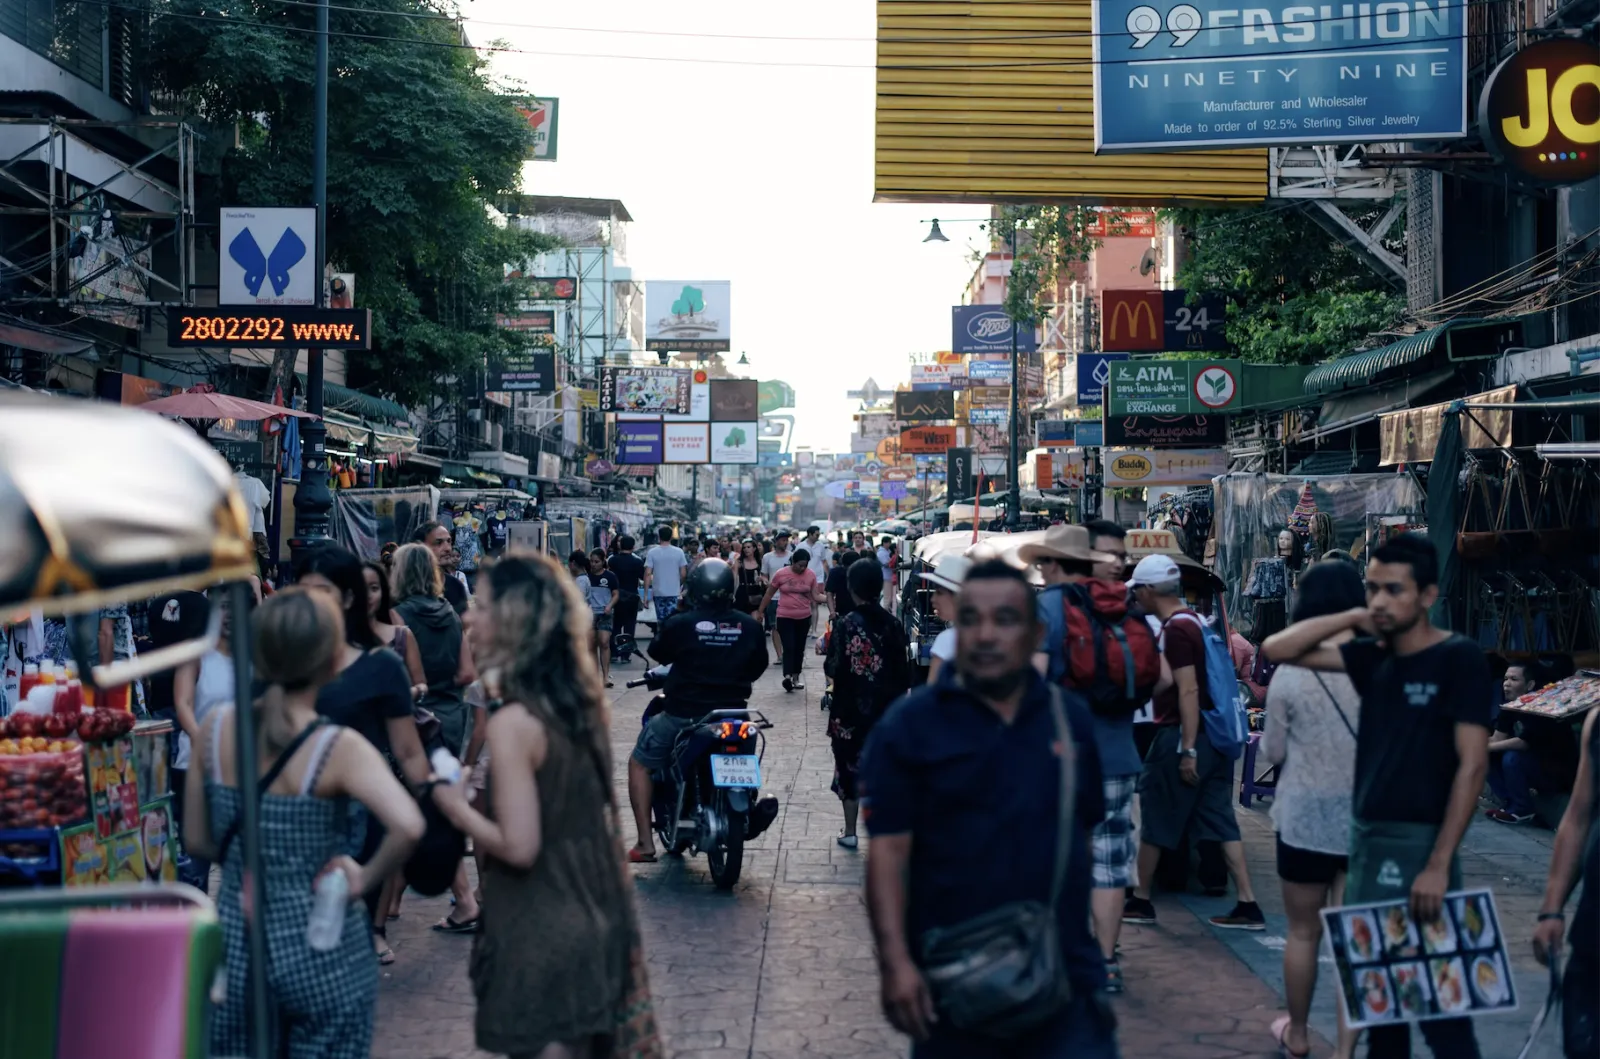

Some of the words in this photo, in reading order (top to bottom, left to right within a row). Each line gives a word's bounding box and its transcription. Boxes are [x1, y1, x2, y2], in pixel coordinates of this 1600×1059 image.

[1128, 68, 1298, 89] NINETY
[1340, 62, 1448, 80] NINE
[1203, 100, 1275, 113] Manufacturer
[1281, 98, 1301, 110] and
[1307, 95, 1368, 108] Wholesaler
[1164, 123, 1192, 134] Made
[1198, 123, 1208, 133] to
[1214, 121, 1241, 133] order
[1247, 120, 1258, 131] of
[1263, 118, 1297, 131] 92.5%
[1303, 116, 1342, 129] Sterling
[1348, 115, 1376, 128] Silver
[1381, 114, 1420, 127] Jewelry
[1175, 307, 1210, 331] 24
[181, 317, 285, 341] 2802292
[292, 323, 360, 341] www.
[1136, 366, 1174, 381] ATM
[602, 368, 613, 410] TATTOO
[678, 376, 688, 414] TATTOO
[1126, 404, 1177, 413] EXCHANGE
[1118, 459, 1146, 471] Buddy
[1131, 534, 1170, 549] TAXI
[721, 775, 754, 784] 7893
